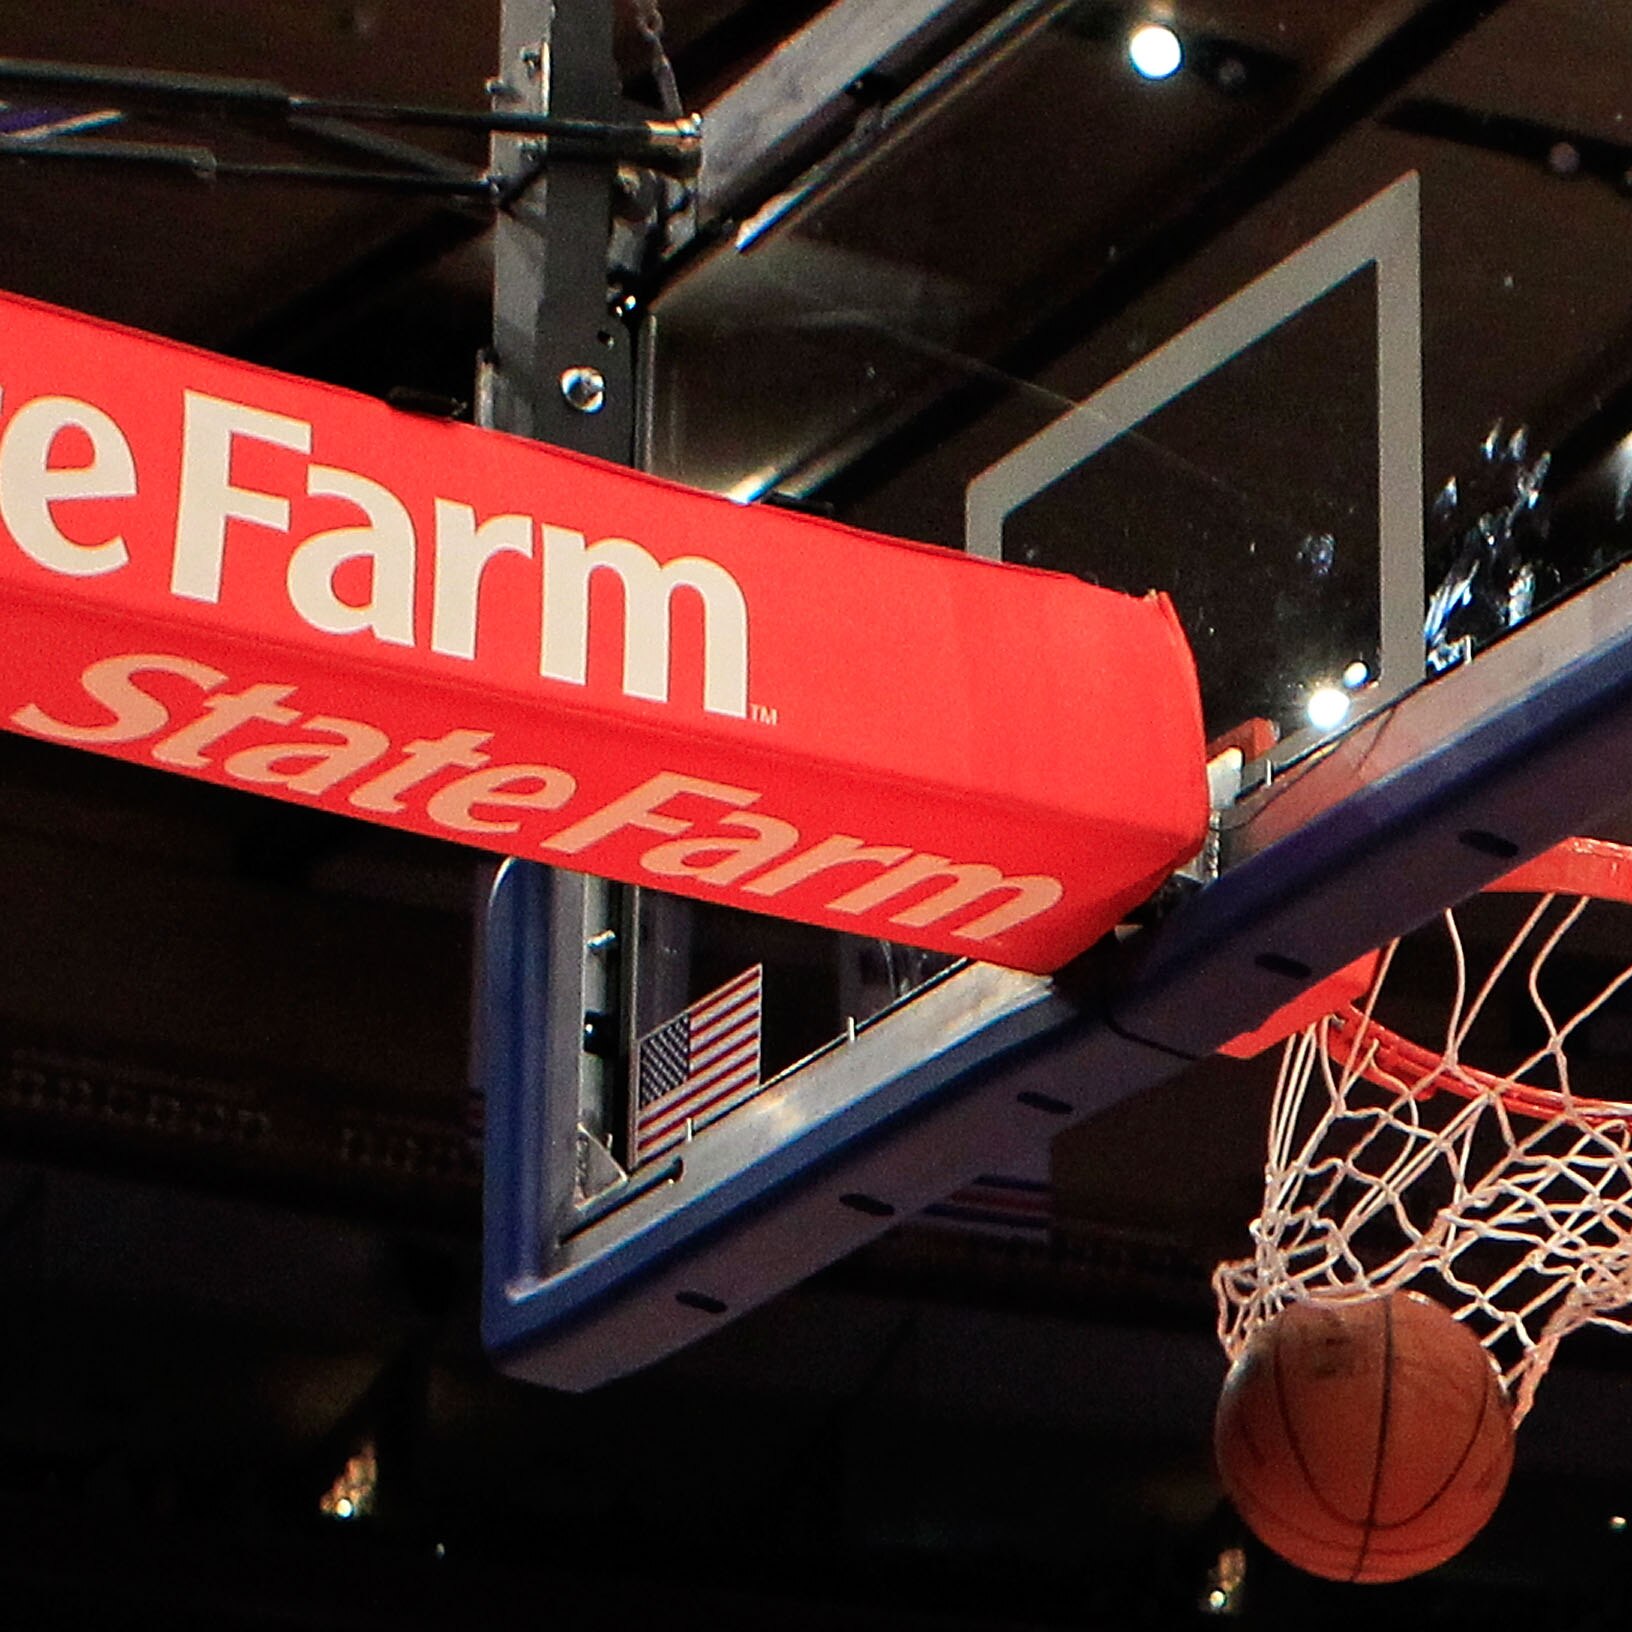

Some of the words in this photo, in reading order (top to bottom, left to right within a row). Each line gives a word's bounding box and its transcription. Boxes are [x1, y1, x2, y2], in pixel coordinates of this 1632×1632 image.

[171, 389, 748, 719] Farm
[12, 653, 605, 836] State
[541, 770, 1064, 943] Farm
